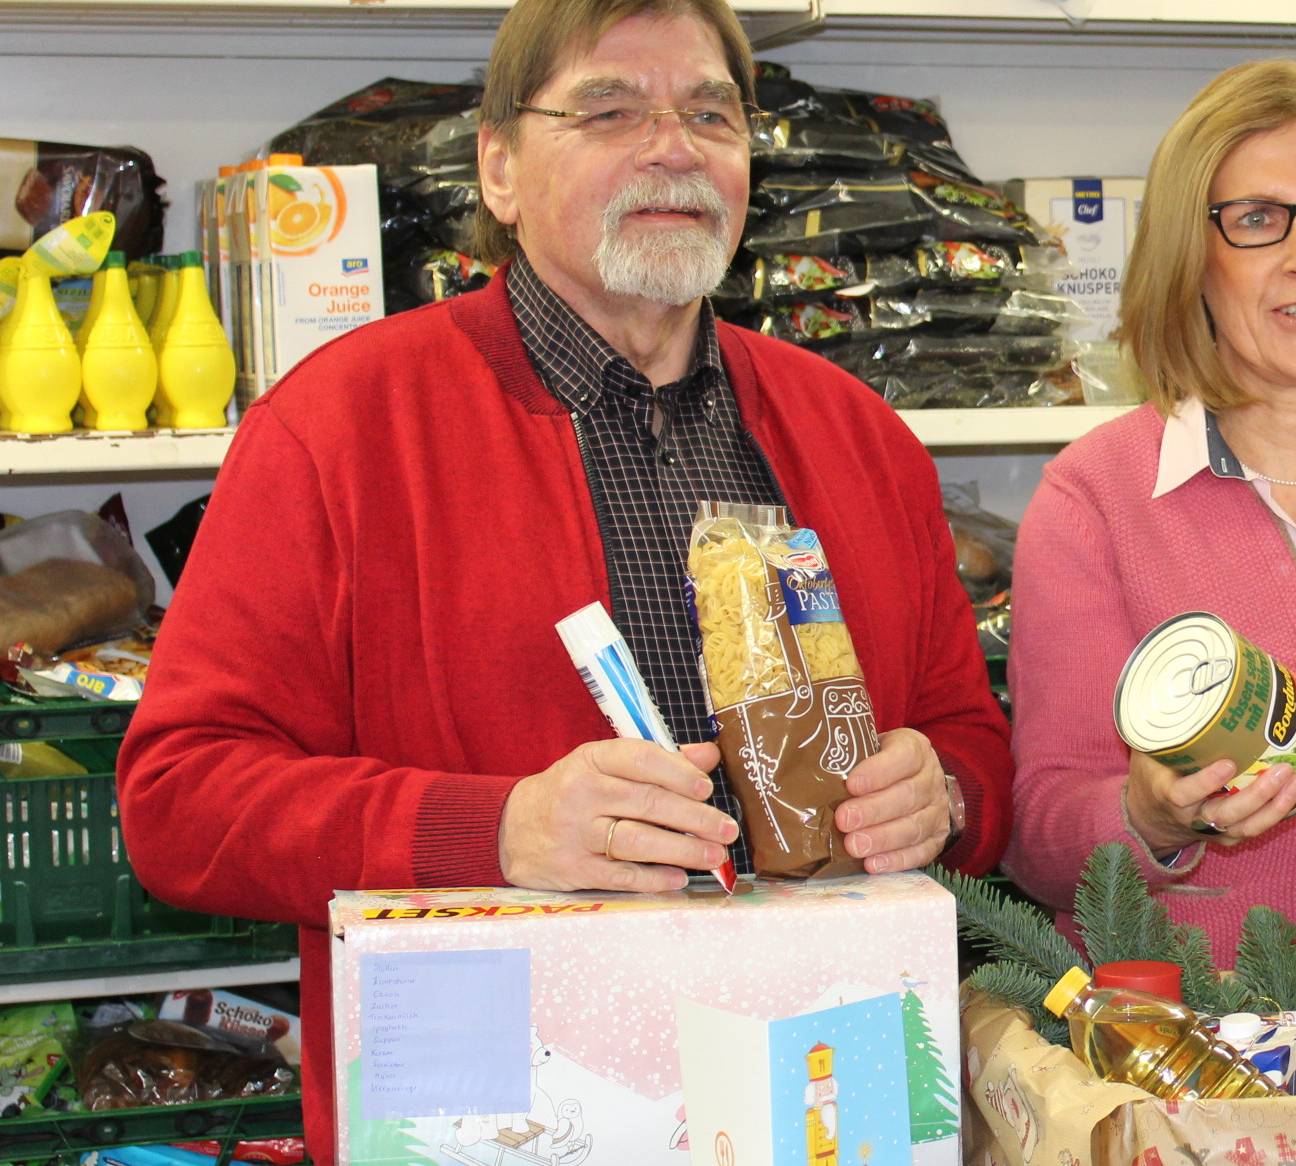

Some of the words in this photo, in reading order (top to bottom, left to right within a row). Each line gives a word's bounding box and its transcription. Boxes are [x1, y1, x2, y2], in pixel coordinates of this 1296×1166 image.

[1077, 204, 1098, 216] Chef
[308, 283, 370, 298] Orange
[1056, 281, 1121, 295] KNUSPER
[326, 300, 371, 314] Juice
[76, 673, 106, 694] aro
[365, 903, 604, 921] PACKSET
[214, 1001, 272, 1027] Schoko
